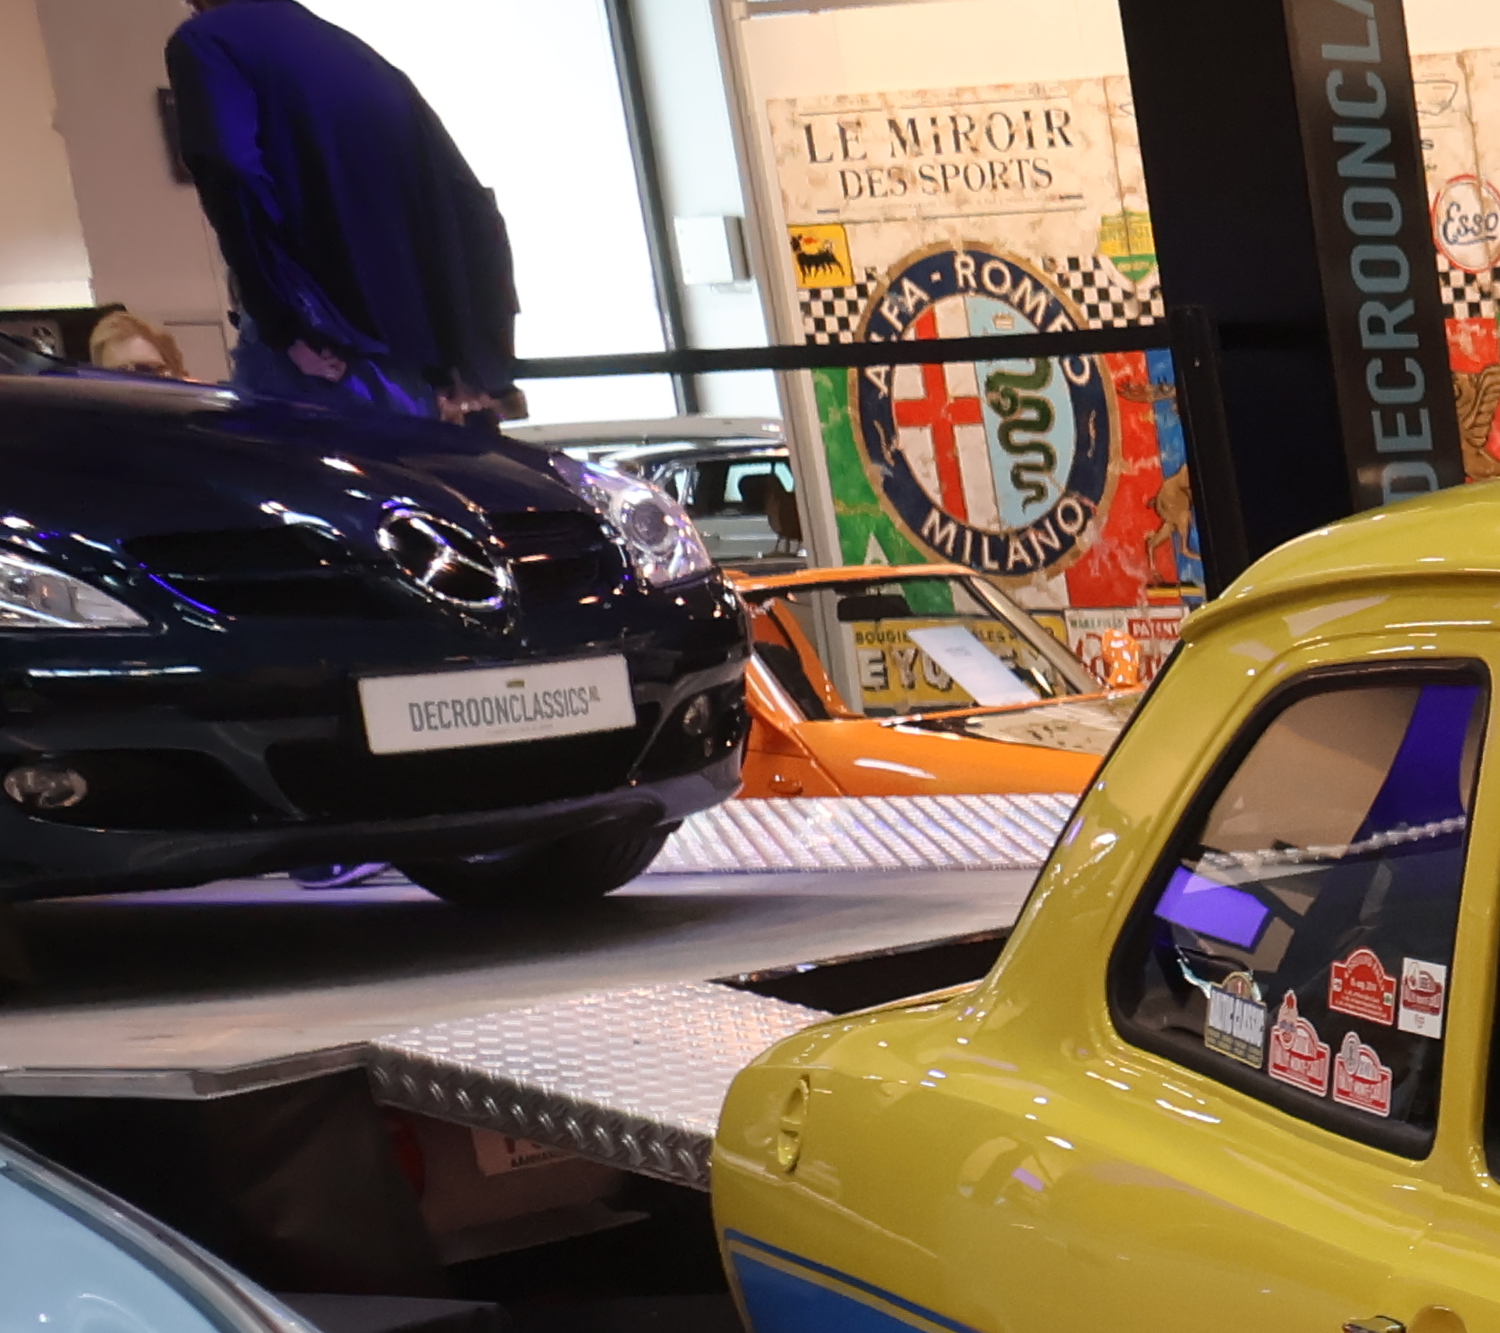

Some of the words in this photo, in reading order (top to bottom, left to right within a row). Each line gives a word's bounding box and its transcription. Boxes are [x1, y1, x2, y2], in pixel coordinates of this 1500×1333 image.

[803, 118, 868, 164] LE
[886, 108, 1075, 158] MIROIR
[838, 164, 908, 201] DES
[917, 157, 1054, 197] SPORTS
[1322, 0, 1440, 507] DECROONCL
[865, 278, 931, 399] AFA
[920, 497, 1086, 571] MILANO
[408, 686, 590, 732] DECROONCLASSICS
